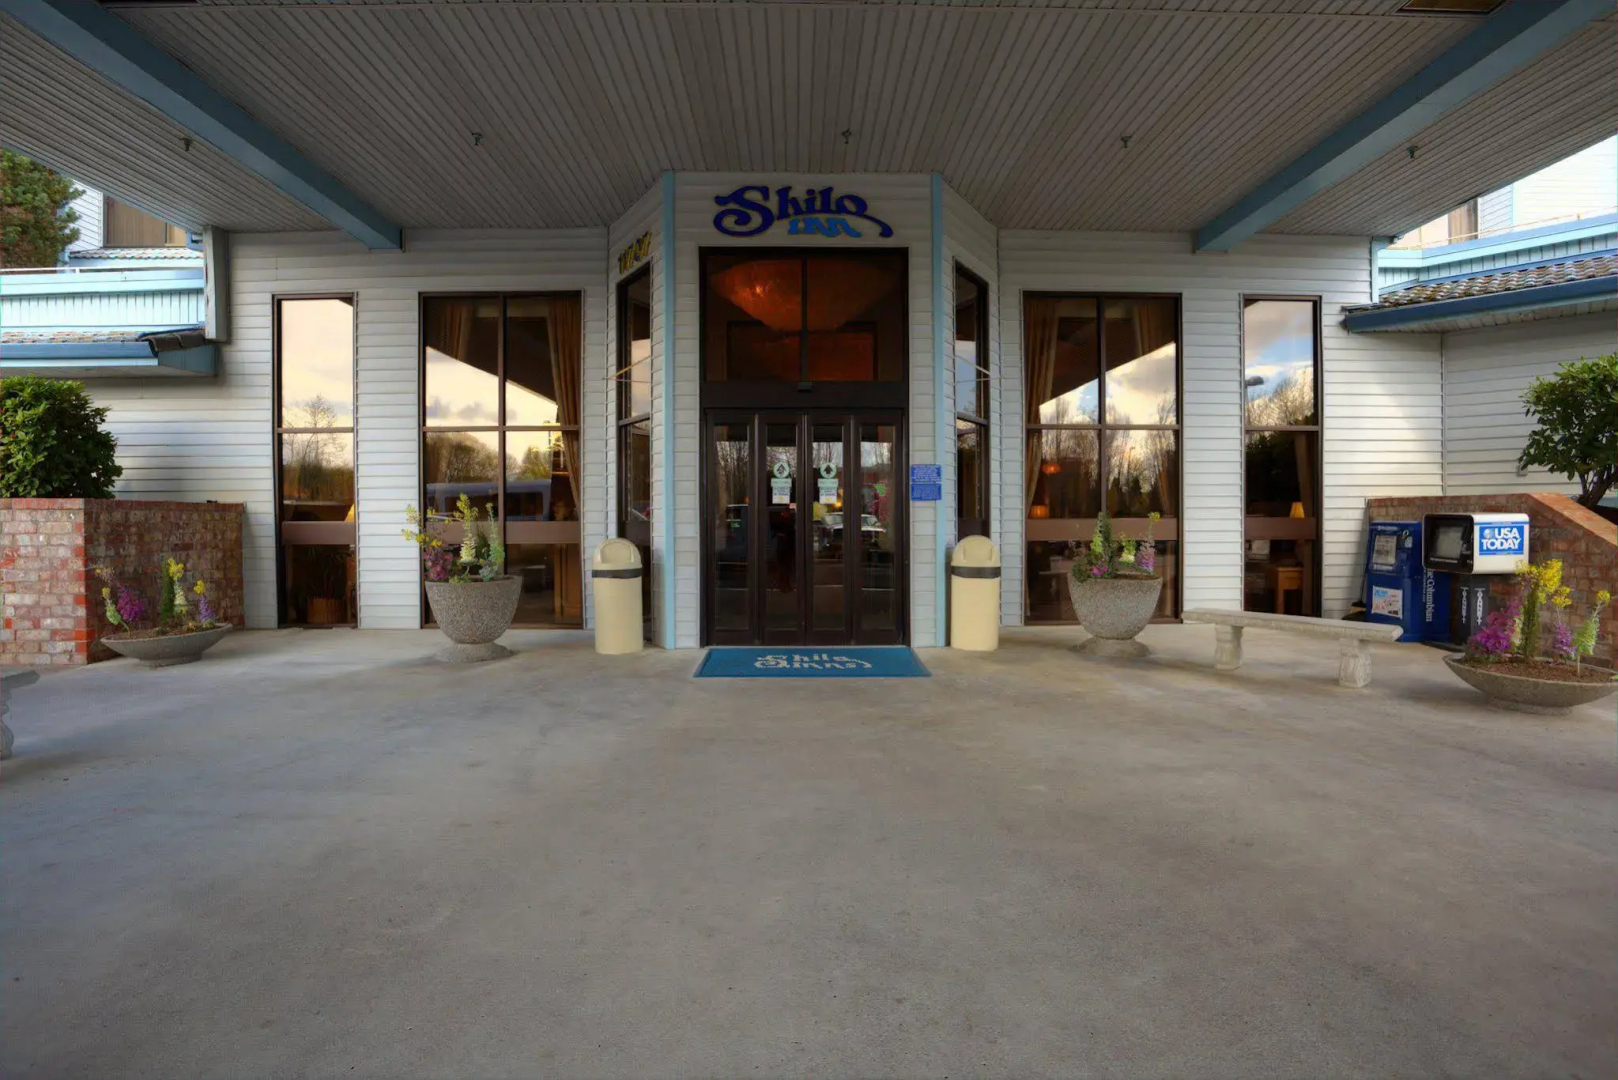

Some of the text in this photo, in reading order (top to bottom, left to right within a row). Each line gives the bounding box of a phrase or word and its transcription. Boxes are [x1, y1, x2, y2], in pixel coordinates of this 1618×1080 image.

[713, 186, 894, 238] Shilo
[1481, 538, 1522, 551] TODAY
[1494, 528, 1521, 539] USA
[1425, 579, 1435, 622] Columbian
